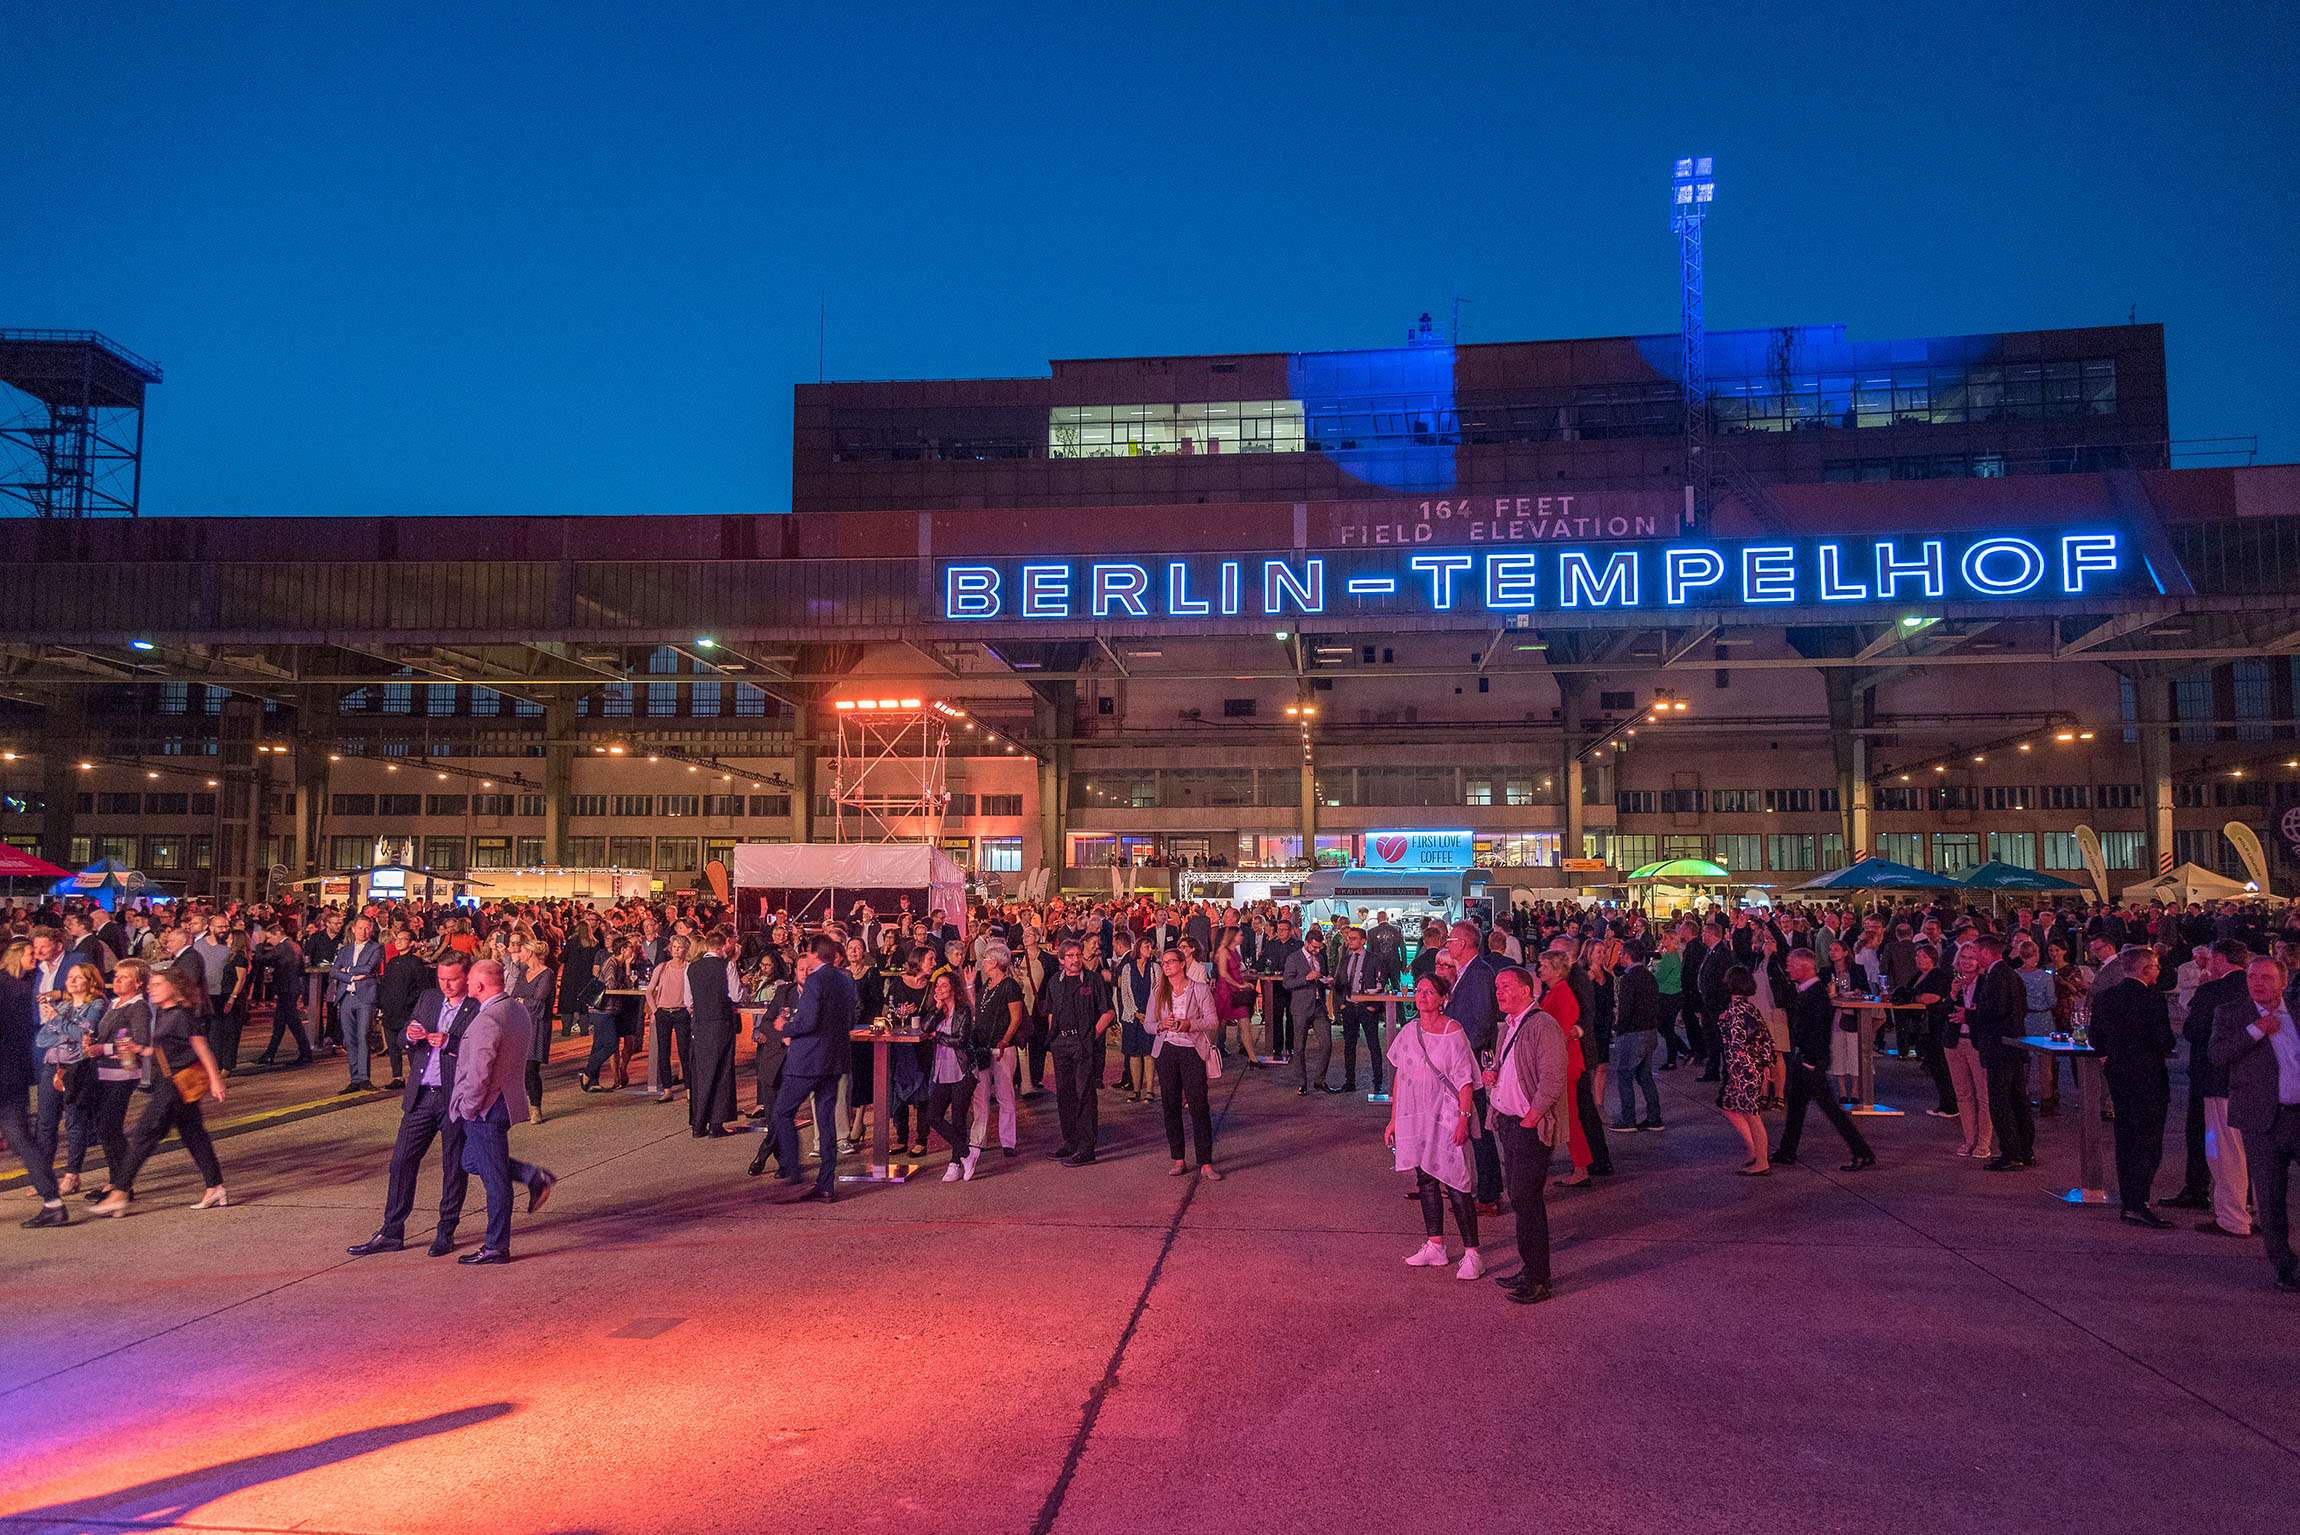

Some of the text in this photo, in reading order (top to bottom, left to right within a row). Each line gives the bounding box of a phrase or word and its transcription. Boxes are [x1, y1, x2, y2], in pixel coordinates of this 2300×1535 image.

[1418, 496, 1575, 520] 164 FEET
[1341, 516, 1656, 544] FIELD ELEVATION
[1411, 835, 1437, 849] FIRST
[1438, 834, 1462, 848] LOVE
[1420, 850, 1454, 864] COFFEE
